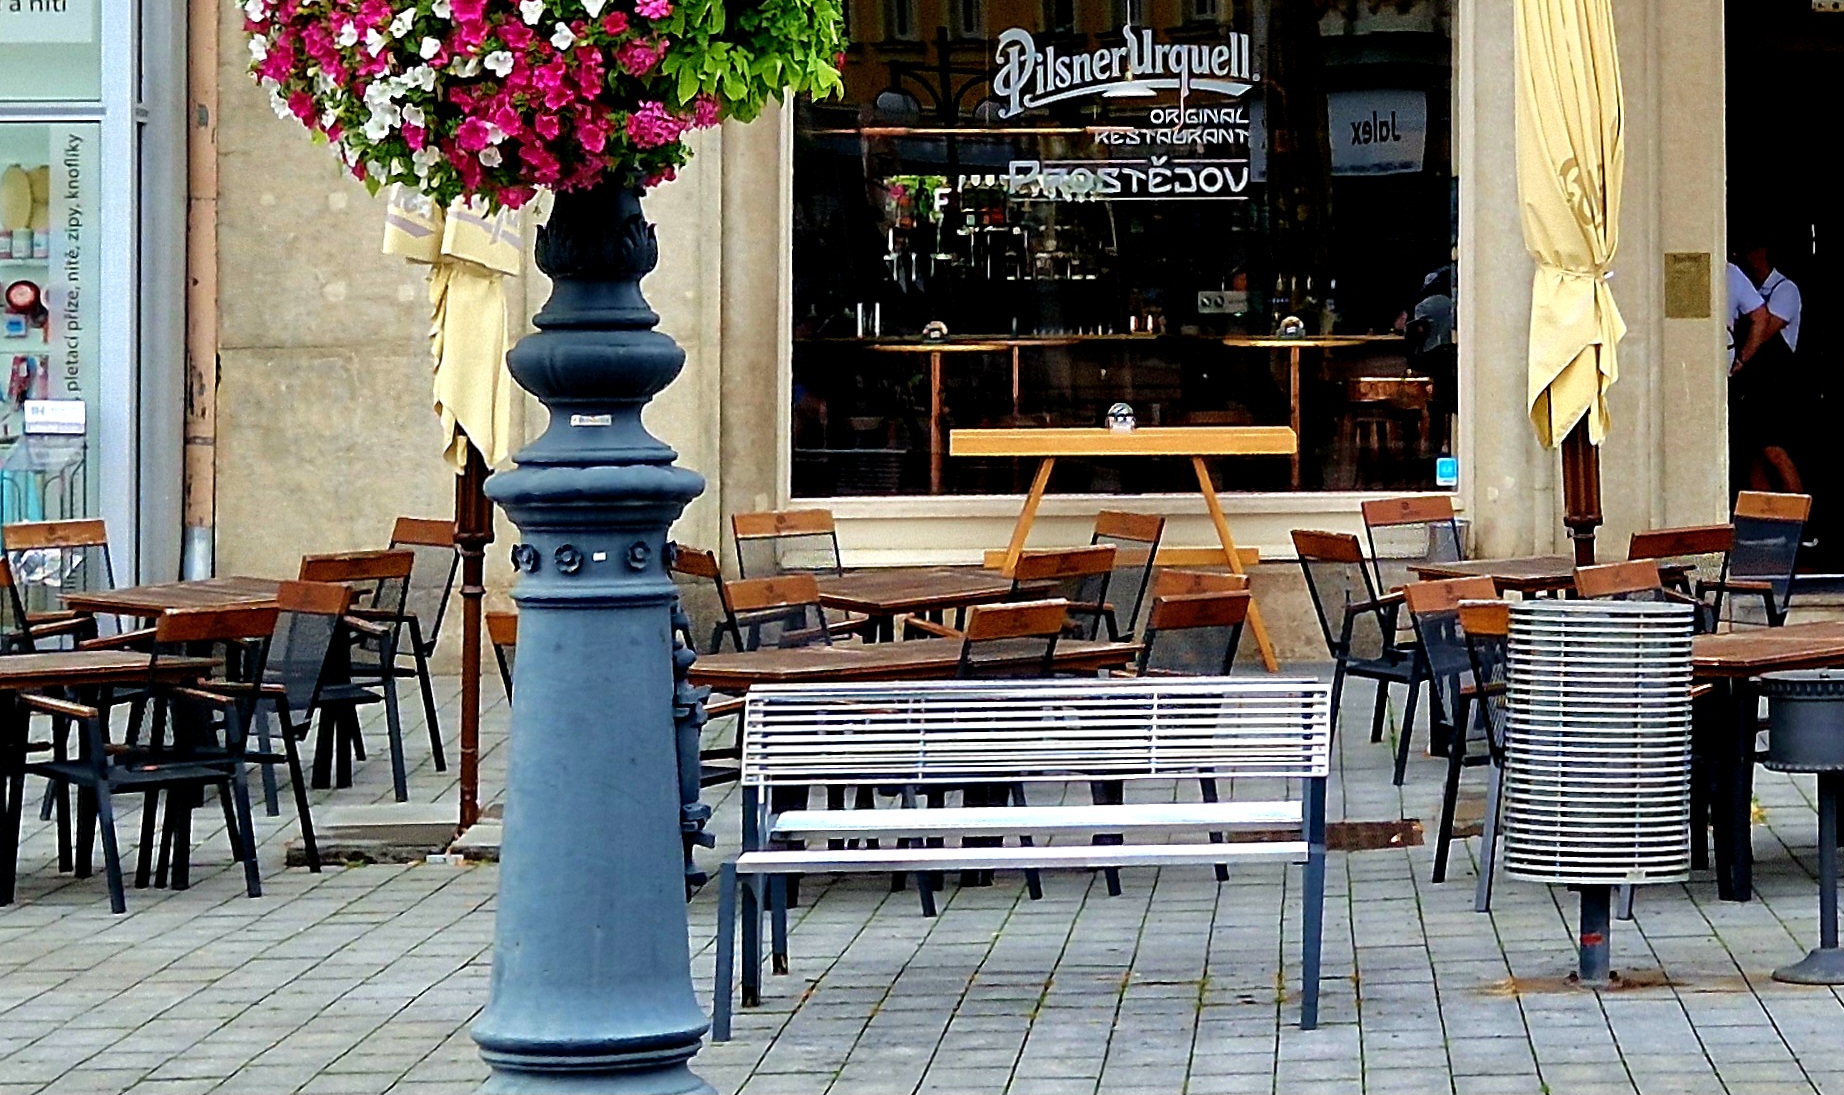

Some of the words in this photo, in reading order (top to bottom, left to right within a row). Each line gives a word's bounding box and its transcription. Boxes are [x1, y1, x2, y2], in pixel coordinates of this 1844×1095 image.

[993, 27, 1127, 119] Pilsner
[1122, 24, 1250, 97] Urquell
[1095, 129, 1249, 144] RESTAURANT
[64, 133, 84, 199] knoflíky
[1009, 156, 1249, 194] PROSTĚJOV
